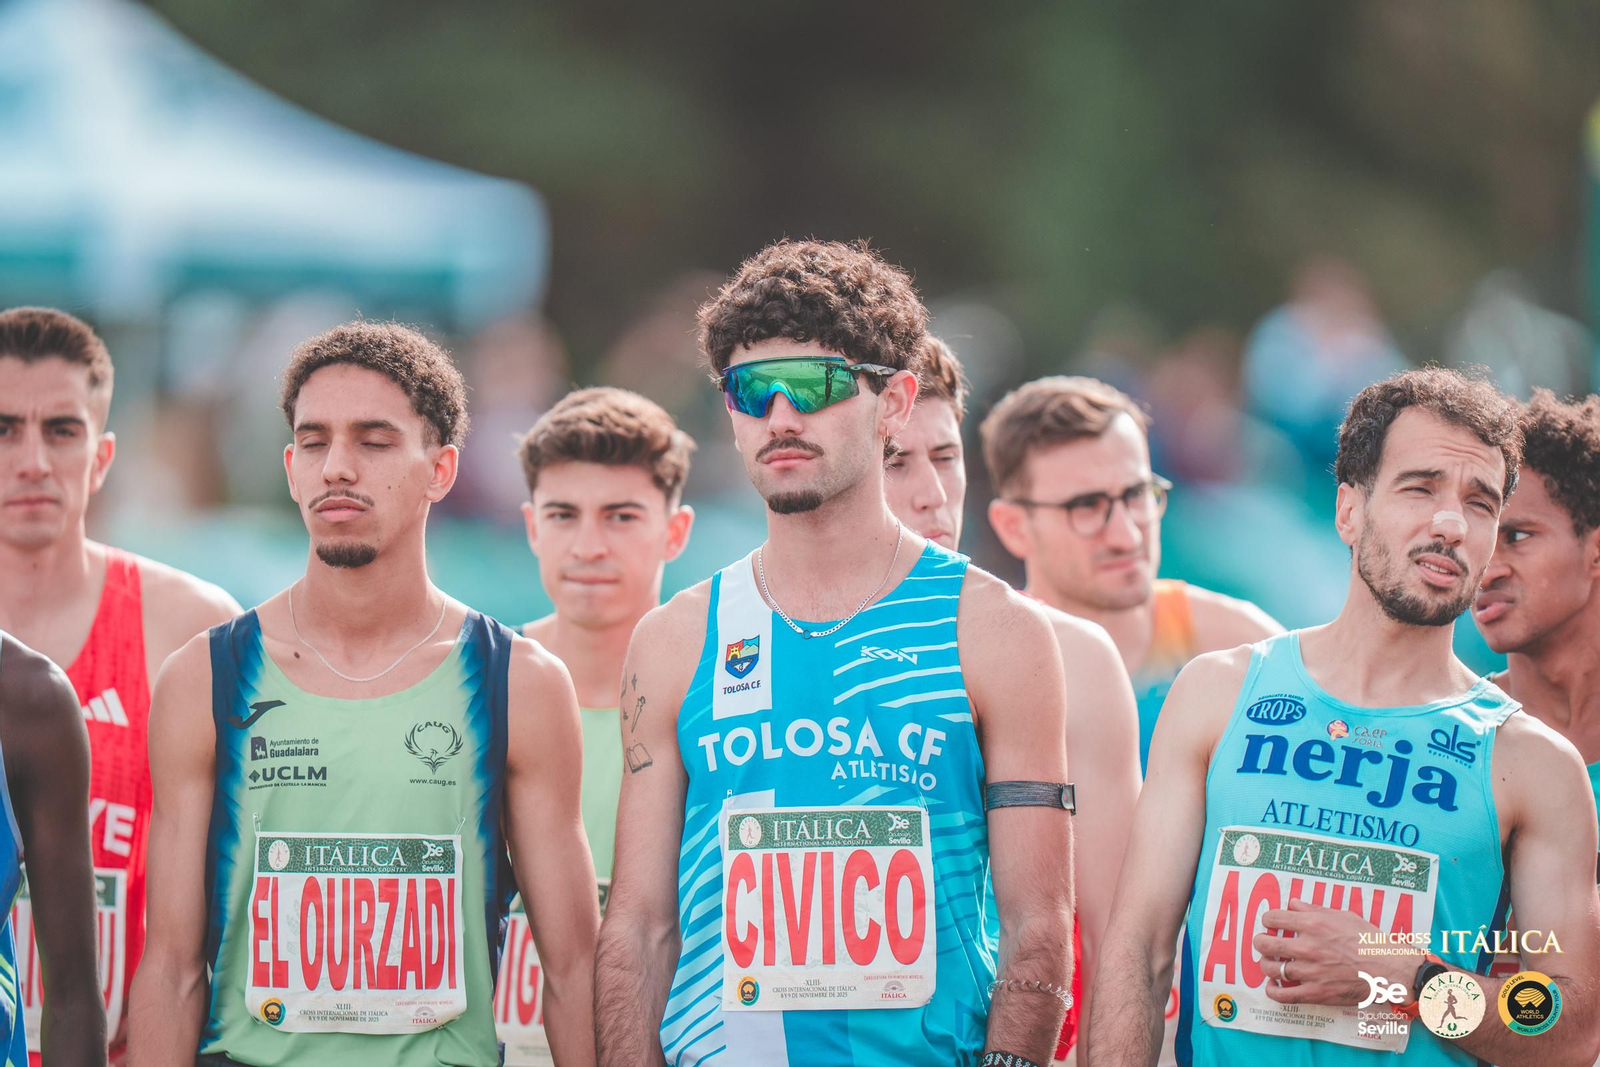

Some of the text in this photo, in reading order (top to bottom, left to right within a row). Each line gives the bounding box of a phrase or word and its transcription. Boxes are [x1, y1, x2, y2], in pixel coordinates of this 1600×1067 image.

[723, 682, 750, 695] TOLOSA
[1249, 699, 1304, 721] TROPS
[417, 721, 451, 734] CAUG
[269, 738, 310, 748] Ayuntamiento
[697, 716, 946, 772] TOLOSA CF
[269, 746, 319, 758] Guadalajara
[262, 766, 327, 781] UCLM
[1236, 733, 1458, 813] nerja
[409, 778, 457, 787] www.caug.es
[772, 814, 873, 841] ITÁLICA
[1260, 798, 1420, 848] ATLETISMO
[888, 836, 911, 844] Sevilla
[304, 841, 407, 867] ITÁLICA
[1273, 841, 1375, 876] ITÁLICA
[421, 864, 444, 872] Sevilla
[1272, 864, 1375, 883] INTERNATIONAL CROSS COUNTRY
[1391, 877, 1415, 889] Sevilla
[726, 848, 926, 968] CIVICO
[252, 876, 289, 988] EL
[299, 875, 457, 991] OURZADI
[1263, 1009, 1306, 1019] INTERNACIONAL
[1274, 1017, 1305, 1026] NOVIEMBRE
